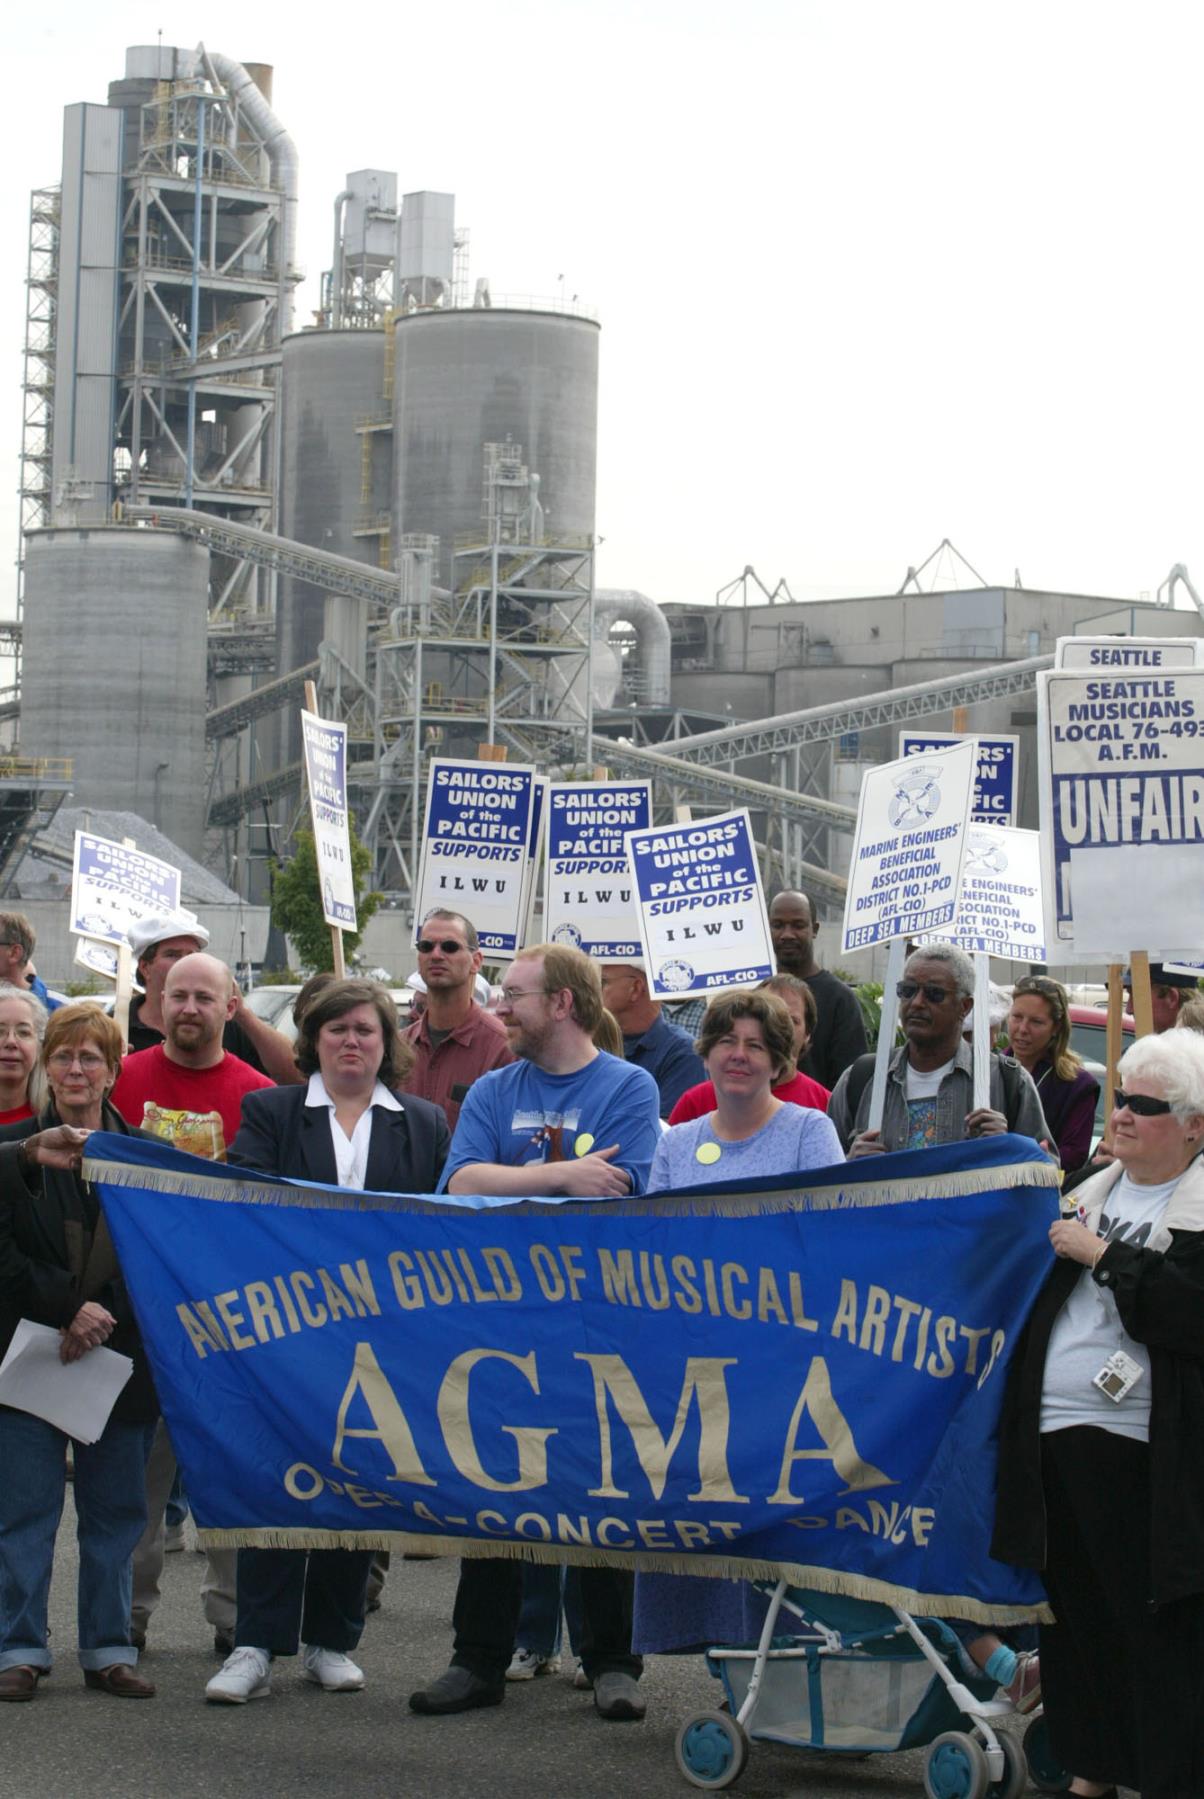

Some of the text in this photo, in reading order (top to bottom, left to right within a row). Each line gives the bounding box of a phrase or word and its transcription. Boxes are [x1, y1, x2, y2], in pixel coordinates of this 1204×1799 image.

[1090, 649, 1162, 666] SEATTLE
[1086, 680, 1175, 700] SEATTLE
[1068, 700, 1195, 721] MUSICIANS
[1054, 723, 1125, 742] LOCAL
[907, 744, 1011, 761] SRS'
[1097, 742, 1168, 761] A.F.M.
[436, 770, 530, 791] SAILORS'
[447, 790, 517, 809] UNION
[553, 792, 647, 809] SAILORS'
[1059, 775, 1204, 845] UNFAIR
[459, 810, 502, 822] of the
[566, 810, 636, 825] UNION
[437, 820, 521, 841] PACIFIC
[579, 827, 622, 838] of the
[635, 821, 744, 855] SAILORS'
[432, 842, 522, 862] SUPPORTS
[558, 839, 625, 855] PACIF
[860, 823, 962, 860] MARINE ENGINEERS'
[653, 842, 735, 868] UNION
[880, 847, 936, 870] BENEFICIAL
[96, 852, 165, 887] UNION
[554, 860, 630, 875] SUPPOR
[672, 863, 722, 878] of the
[872, 862, 941, 890] ASSOCIATION
[88, 866, 172, 907] PACIFIC
[650, 868, 749, 897] PACIFIC
[972, 878, 1038, 897] ENGINEERS'
[84, 877, 171, 917] SUPPORTS
[649, 887, 753, 917] SUPPORTS
[856, 887, 900, 911] DISTRICT
[960, 890, 1013, 905] NEFICIAL
[878, 896, 926, 920] (AFL-CIO)
[959, 902, 1020, 919] SOCIATION
[847, 927, 875, 949] DEEP
[877, 920, 896, 940] SEA
[899, 905, 953, 933] MEMBERS
[953, 925, 1009, 941] (AFL-CIO)
[590, 945, 635, 956] AFL-CIO
[956, 937, 979, 951] SEA
[984, 939, 1042, 960] MEMBERS
[706, 970, 758, 987] AFL-CIO
[387, 1246, 523, 1311] GUILD
[529, 1244, 587, 1302] OF
[597, 1248, 819, 1332] MUSICAL
[831, 1278, 1006, 1391] ARTISTS
[332, 1342, 901, 1505] AGMA
[785, 1500, 936, 1547] DANCE
